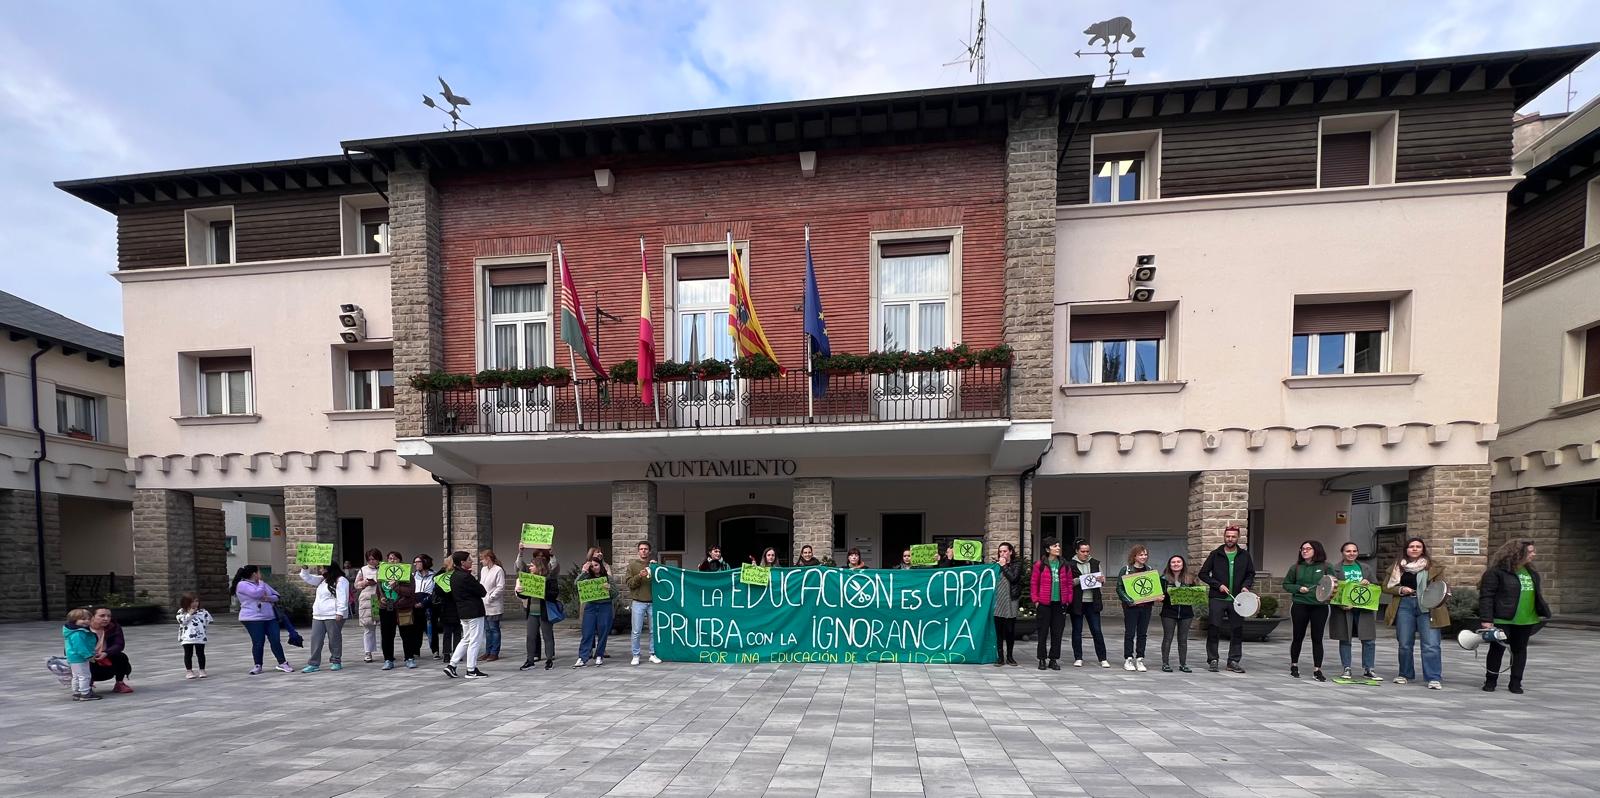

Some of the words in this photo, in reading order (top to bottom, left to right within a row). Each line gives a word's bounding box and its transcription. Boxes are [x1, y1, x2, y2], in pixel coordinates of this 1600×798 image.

[645, 459, 797, 478] AYUNTAMIENTO
[654, 566, 686, 608] SI
[701, 588, 723, 608] LA
[901, 589, 922, 610] ES
[926, 568, 996, 608] CARA
[656, 610, 743, 649] PRUEBA
[746, 631, 774, 646] CON
[780, 632, 798, 646] LA
[812, 615, 976, 651] IGNORANCIA
[699, 651, 729, 664] POR
[735, 652, 760, 664] UNA
[770, 650, 839, 664] EDUCACIÓN
[844, 651, 857, 664] DE
